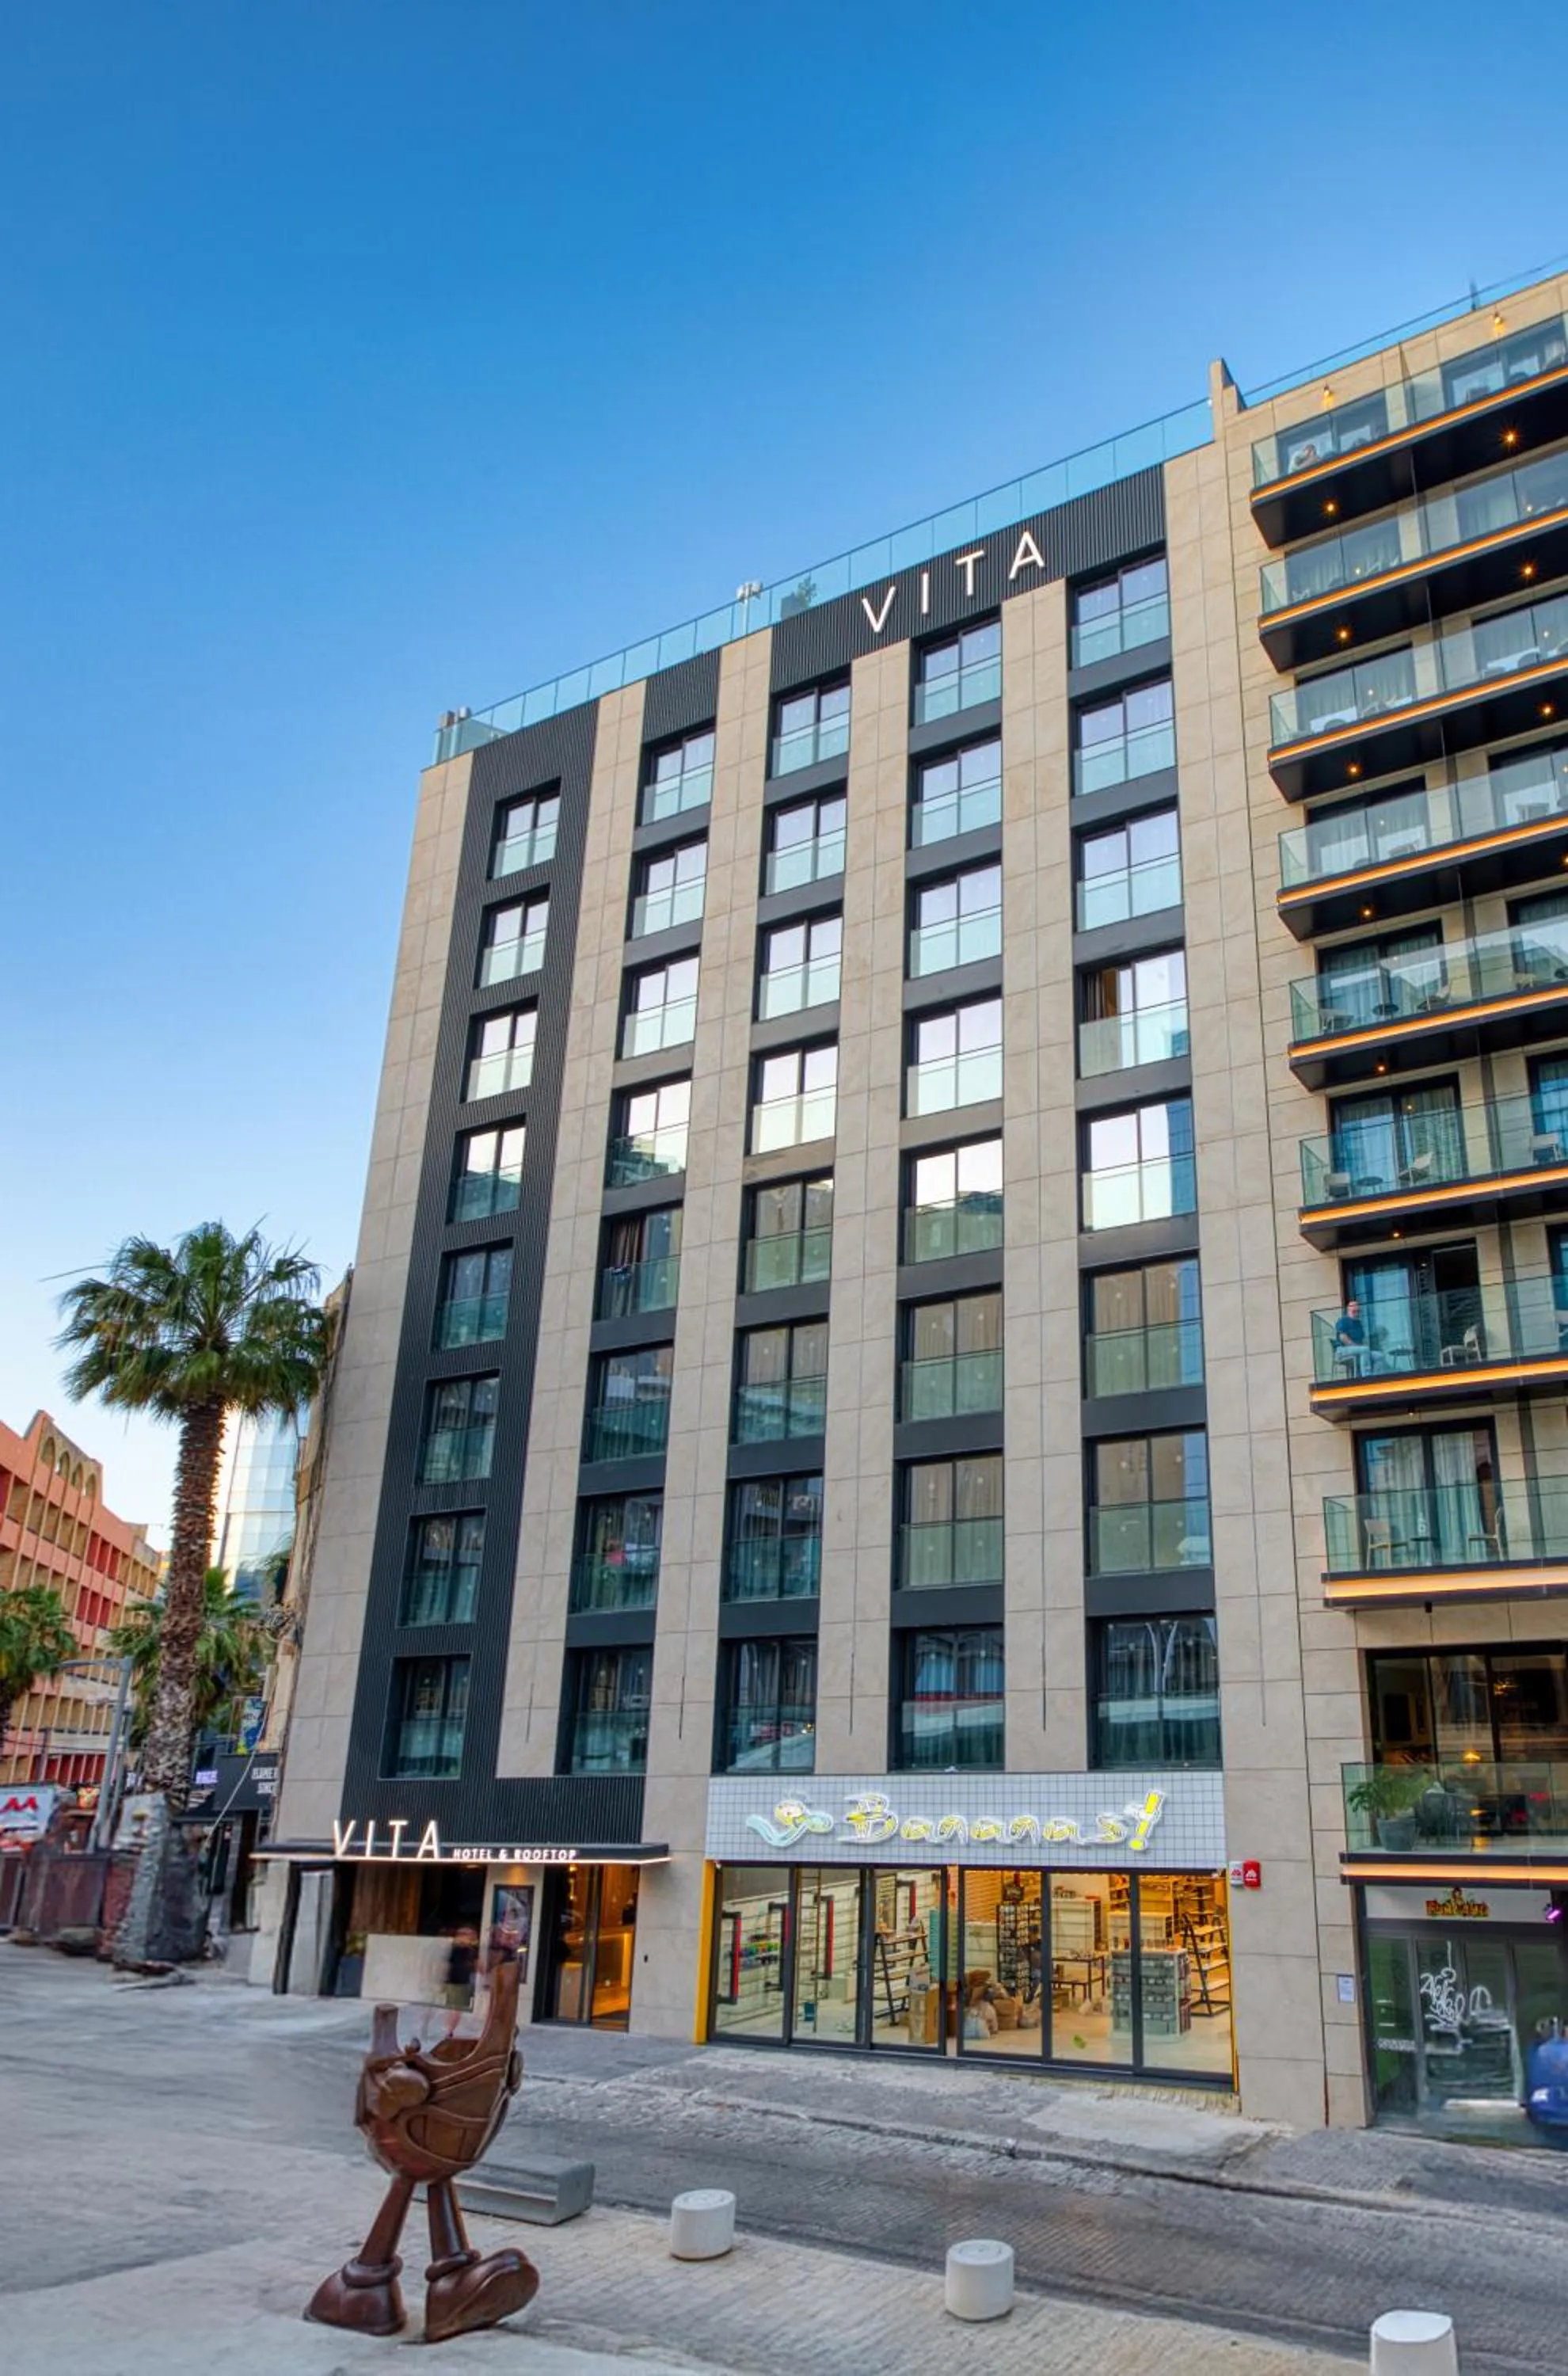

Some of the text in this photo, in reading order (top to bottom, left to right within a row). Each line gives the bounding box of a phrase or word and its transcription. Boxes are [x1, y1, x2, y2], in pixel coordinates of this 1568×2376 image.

[862, 530, 1045, 633] VITA
[333, 1819, 440, 1859] VITA
[452, 1848, 577, 1860] HOTEL & ROOFTOP
